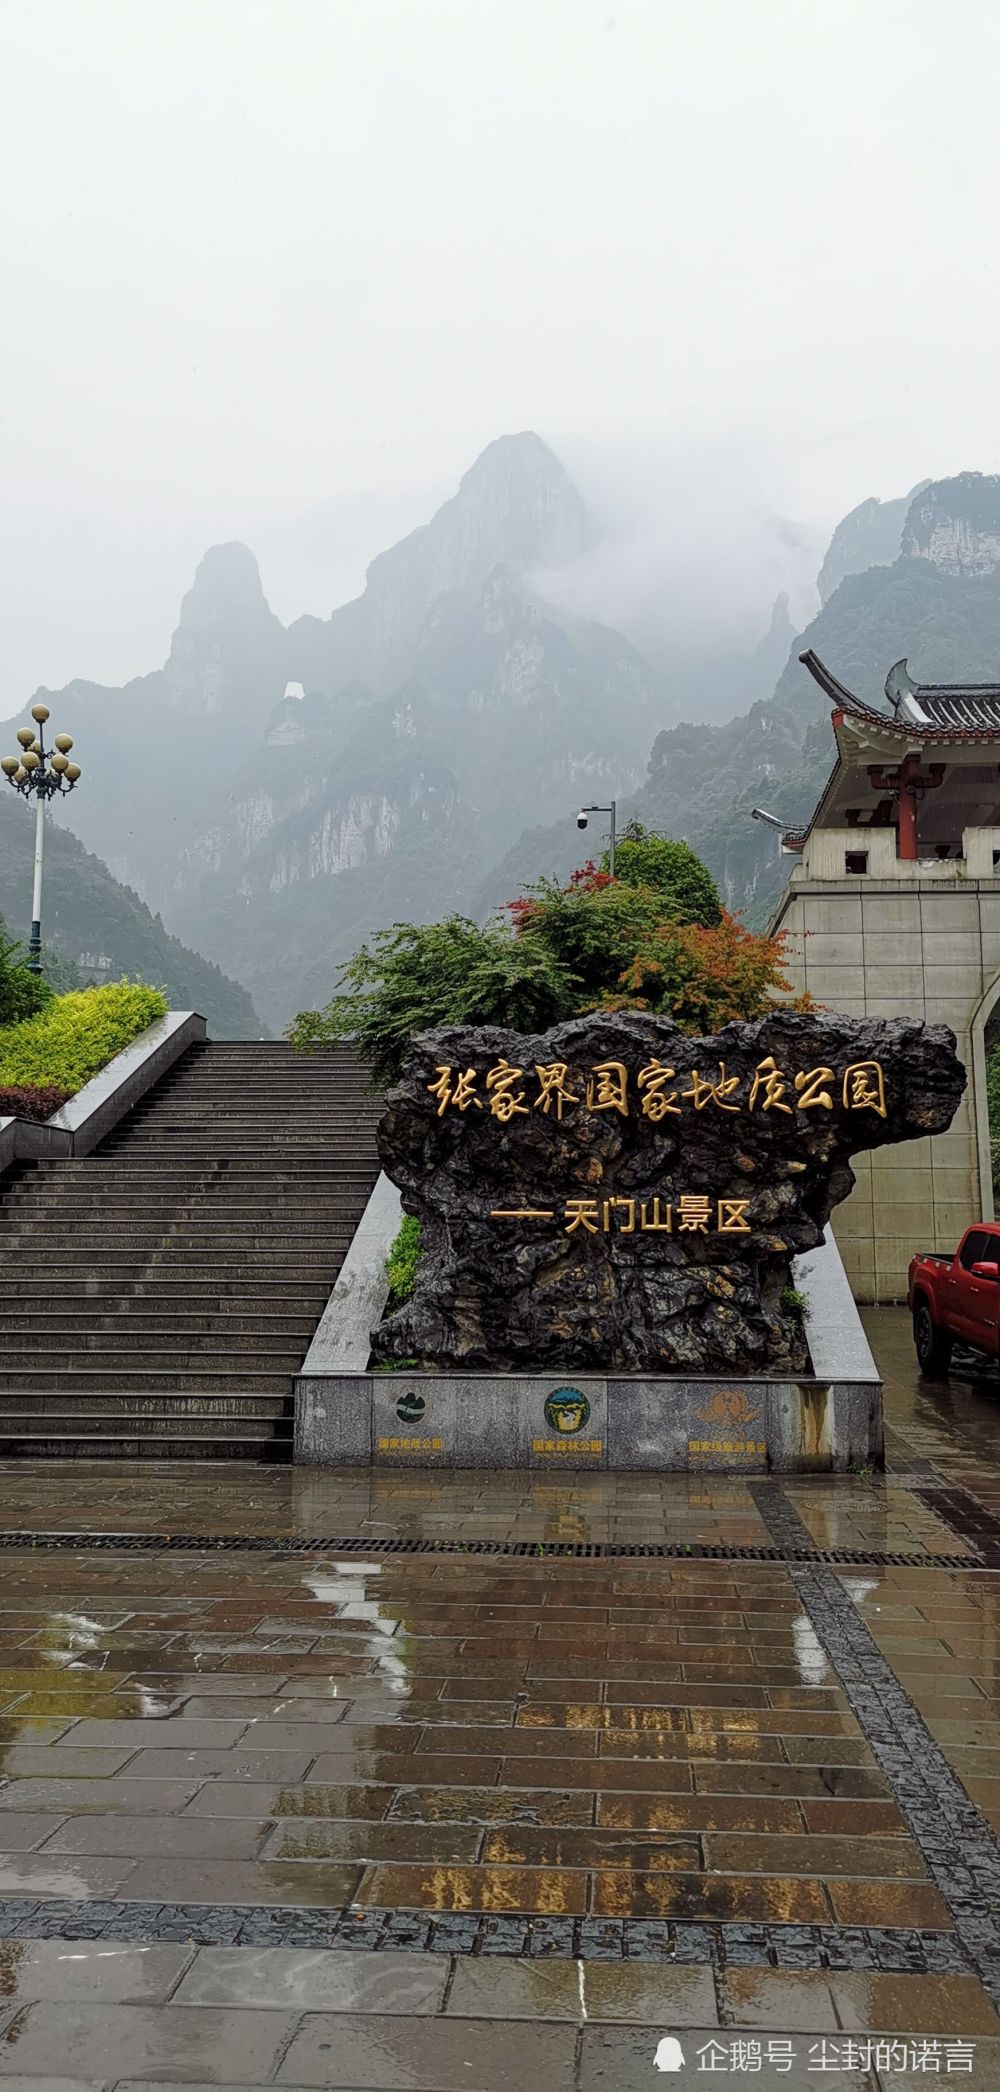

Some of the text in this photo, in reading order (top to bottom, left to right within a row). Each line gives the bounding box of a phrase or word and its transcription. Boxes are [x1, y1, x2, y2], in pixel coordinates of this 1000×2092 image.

[427, 1056, 888, 1122] 张家界国家地质公园
[533, 1438, 602, 1452] 国家森林公园
